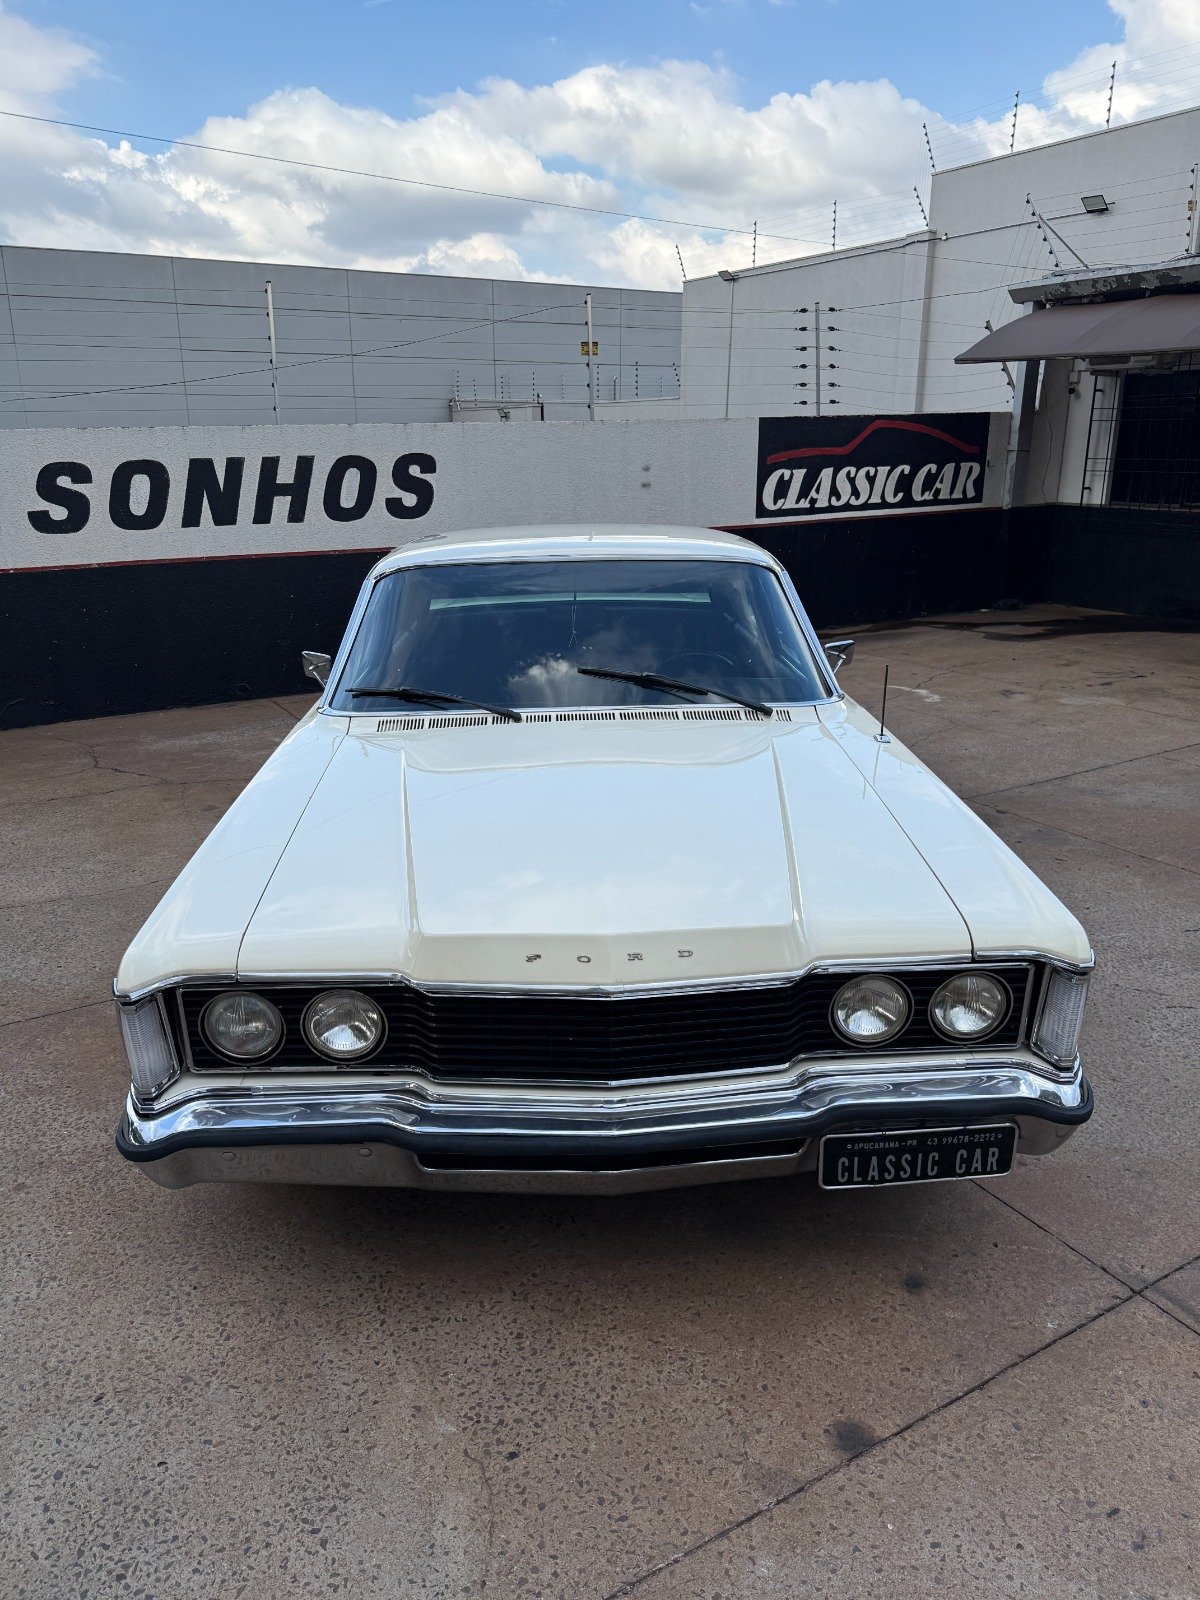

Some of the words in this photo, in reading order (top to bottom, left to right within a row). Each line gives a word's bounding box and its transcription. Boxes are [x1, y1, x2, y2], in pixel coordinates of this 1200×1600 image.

[27, 452, 437, 535] SONHOS
[762, 465, 910, 511] CLASSIC
[911, 462, 981, 502] CAR
[525, 949, 694, 963] FORD
[854, 1141, 899, 1150] APUCARANA
[907, 1139, 917, 1147] PR
[927, 1138, 938, 1146] 43
[942, 1133, 996, 1145] 99678-2272
[837, 1151, 939, 1183] CLASSIC
[955, 1147, 999, 1174] CAR
